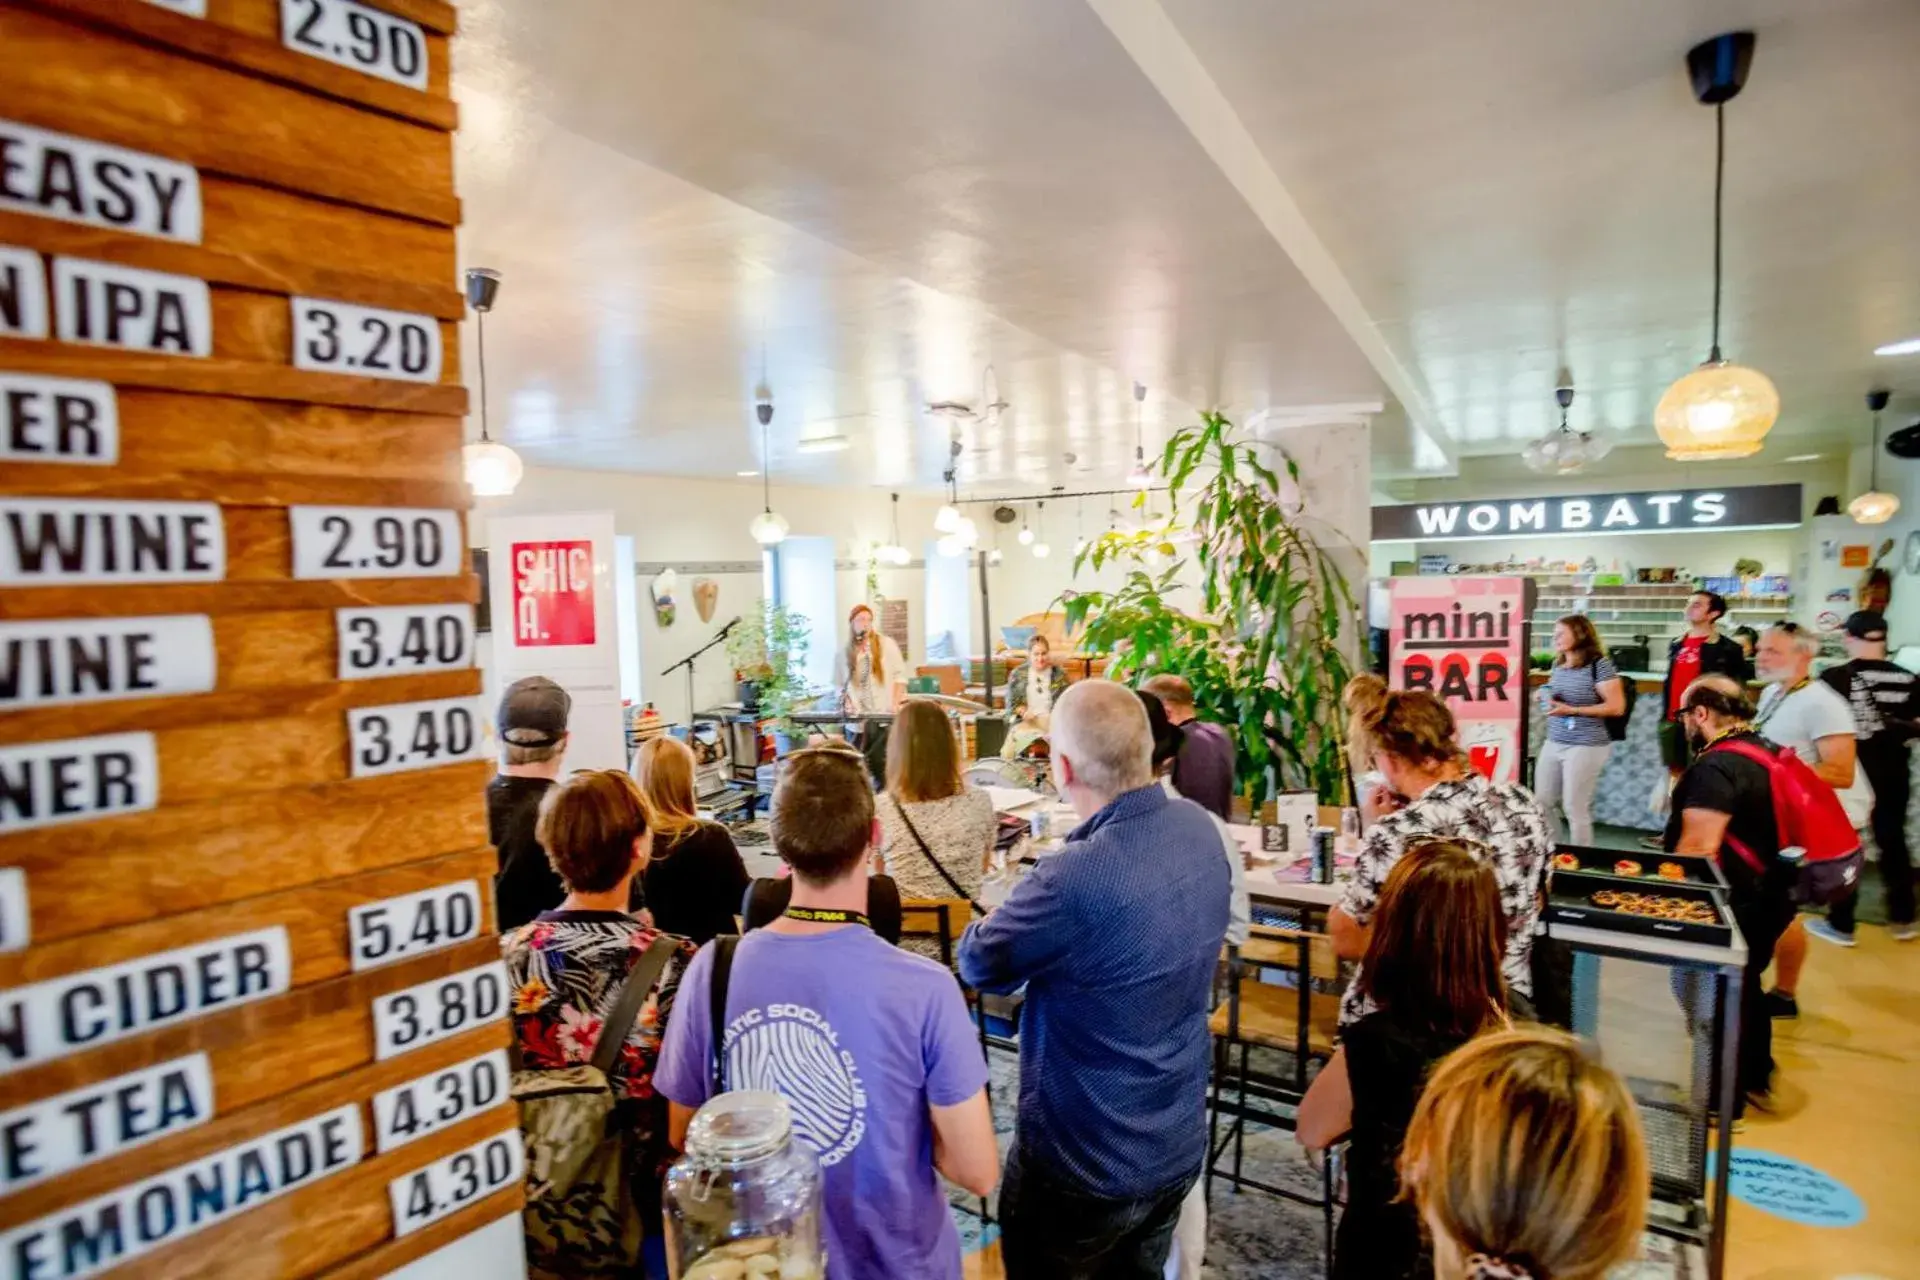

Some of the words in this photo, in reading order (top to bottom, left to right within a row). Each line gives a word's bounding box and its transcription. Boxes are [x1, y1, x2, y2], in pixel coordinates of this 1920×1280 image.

[293, 0, 422, 79] 2.90
[72, 276, 193, 352] IPA
[305, 309, 430, 375] 3.20
[7, 390, 100, 457] ER
[5, 511, 212, 573] WINE
[321, 516, 442, 568] 2.90
[1416, 493, 1728, 534] WOMBATS
[516, 548, 589, 593] SHIC
[348, 615, 464, 669] 3.40
[518, 596, 550, 640] A.
[1403, 601, 1510, 638] mini
[1403, 663, 1509, 701] BAR
[359, 706, 474, 767] 3.40
[813, 910, 846, 921] FM4
[60, 943, 271, 1046] CIDER
[359, 891, 474, 959] 5.40
[767, 1003, 839, 1047] SOCIAL
[1, 1117, 42, 1184] E
[66, 1069, 199, 1158] TEA
[389, 973, 500, 1046] 3.80
[390, 1060, 498, 1136] 4.30
[406, 1139, 512, 1219] 4.30
